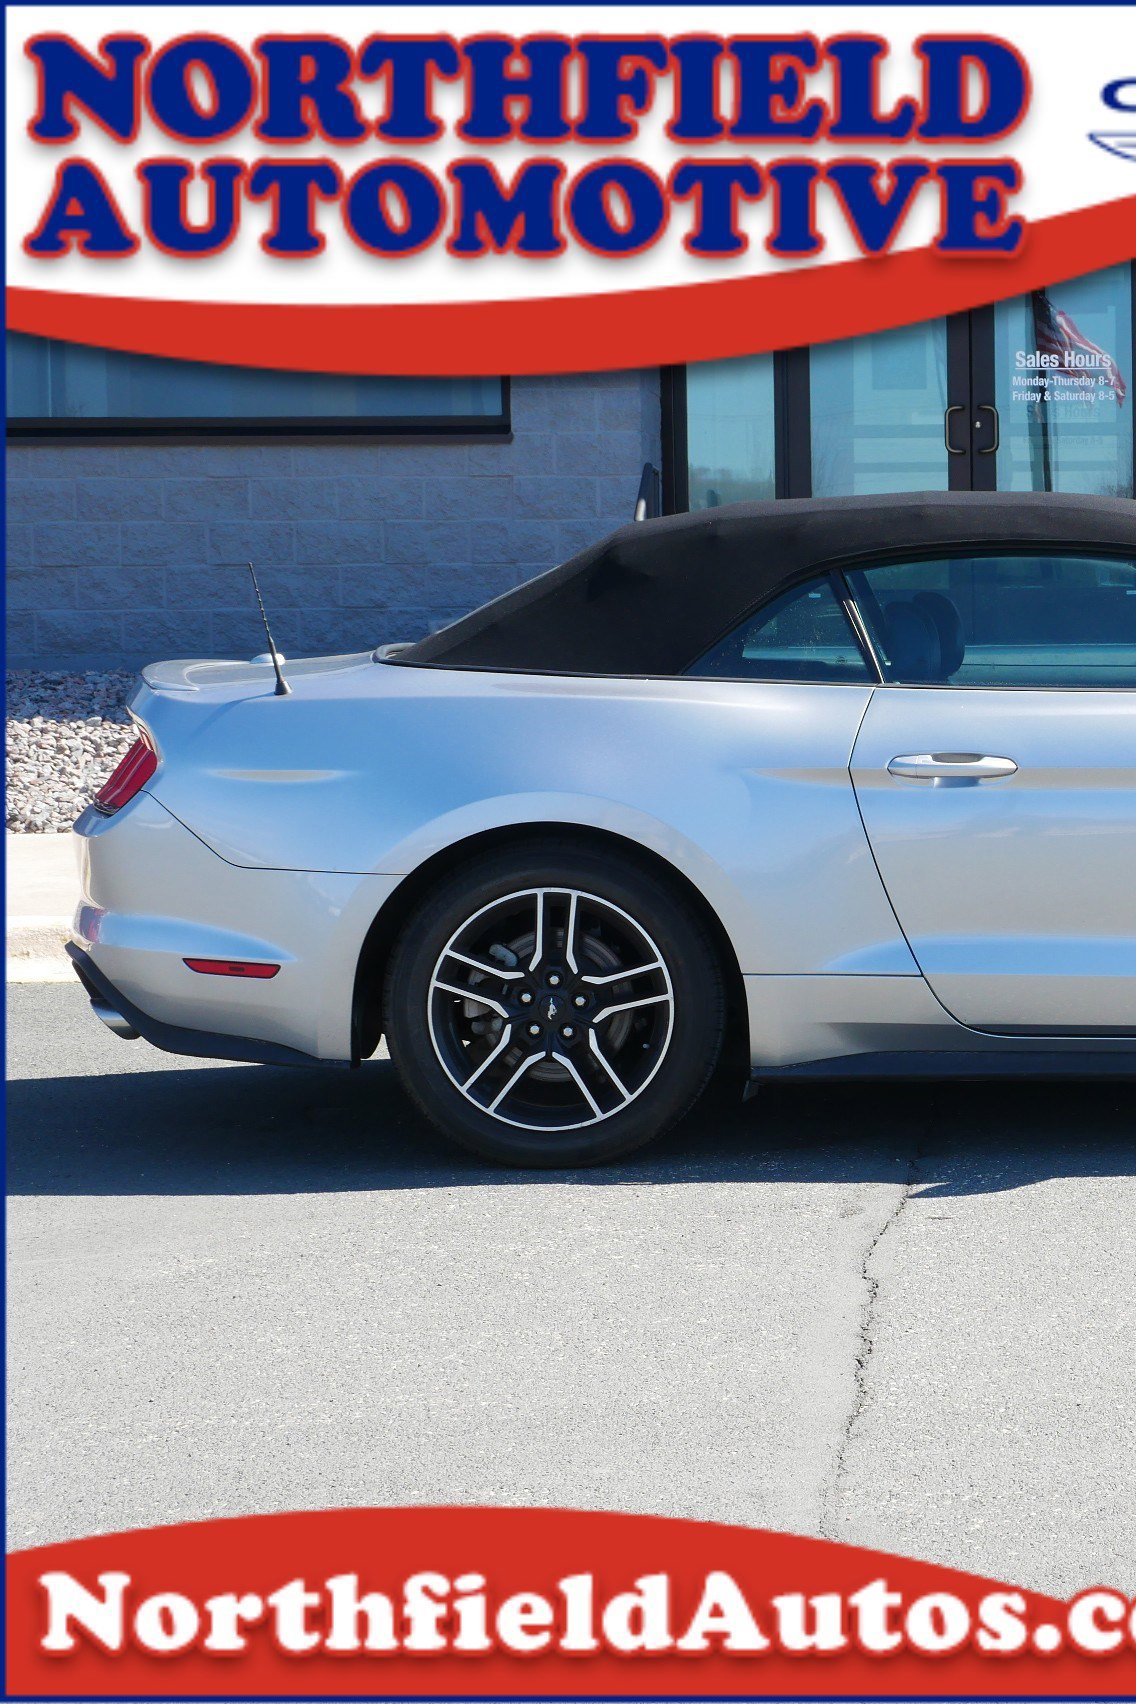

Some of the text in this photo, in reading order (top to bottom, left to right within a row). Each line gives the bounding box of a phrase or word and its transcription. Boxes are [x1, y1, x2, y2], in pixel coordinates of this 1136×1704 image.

[1015, 350, 1112, 368] Sales Hours
[1012, 375, 1096, 387] Monday-Thursday
[1012, 390, 1115, 403] Friday & Saturday 8-5
